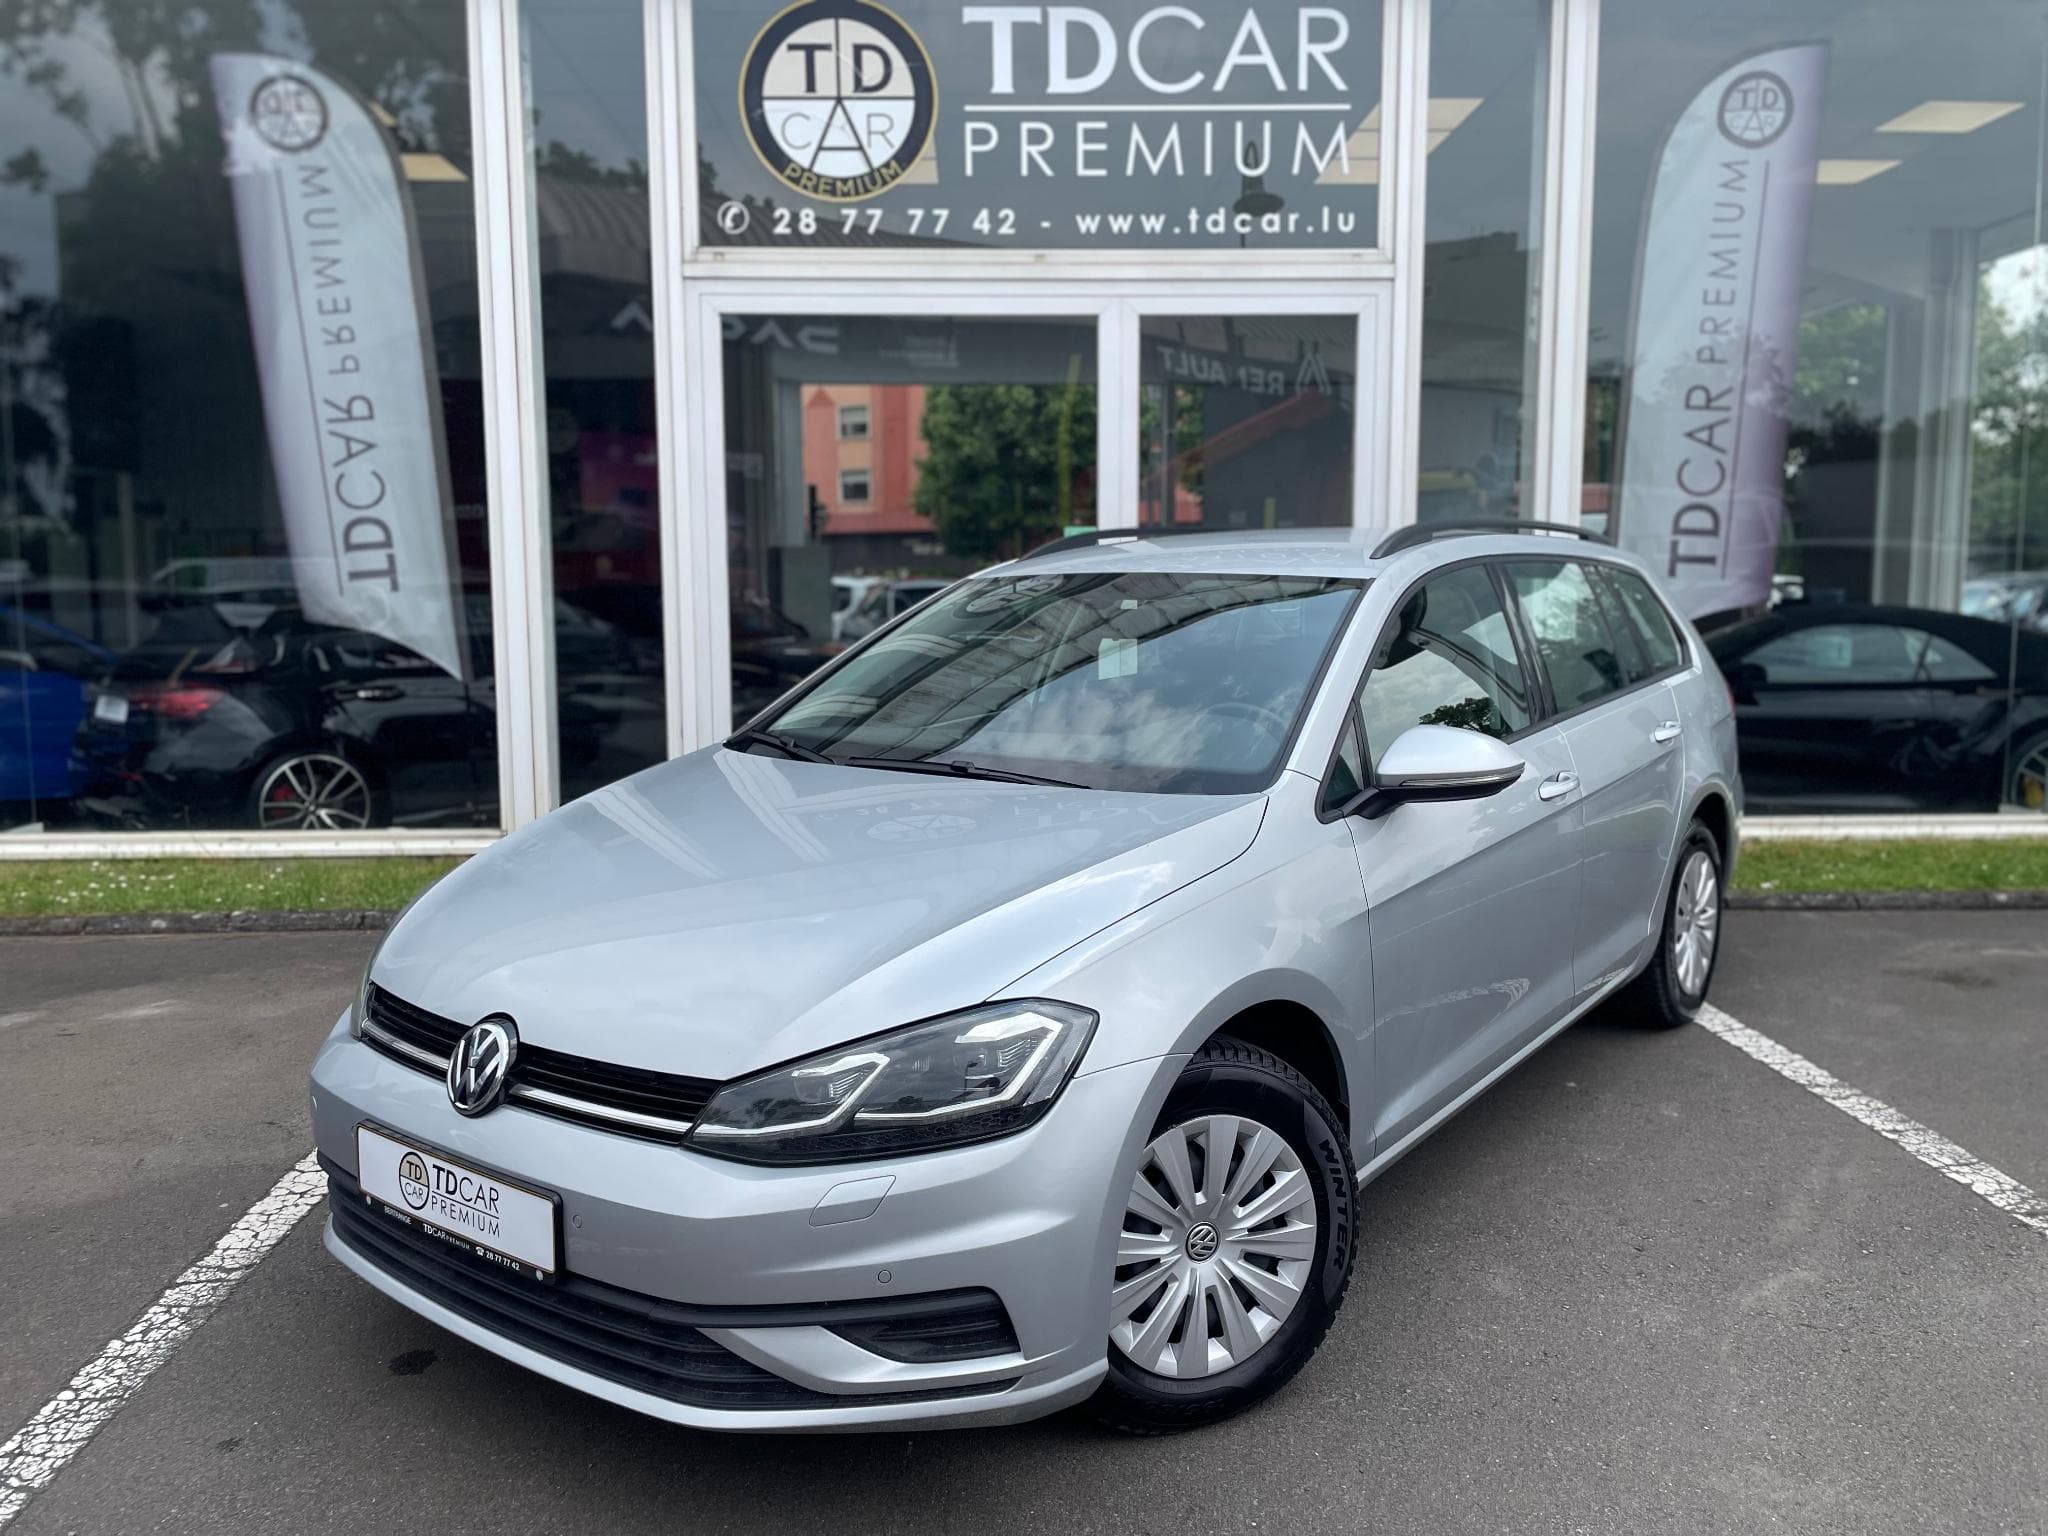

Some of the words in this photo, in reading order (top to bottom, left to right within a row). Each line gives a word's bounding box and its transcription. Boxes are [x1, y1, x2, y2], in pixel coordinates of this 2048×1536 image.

[786, 43, 893, 94] TD
[962, 6, 1350, 94] TDCAR
[1736, 86, 1779, 111] TD
[781, 99, 895, 172] CAR
[963, 120, 1351, 177] PREMIUM
[783, 159, 904, 198] PREMIUM
[773, 207, 818, 236] 28
[840, 208, 884, 235] 77
[907, 208, 950, 235] 77
[972, 208, 1017, 235] 42
[1074, 206, 1356, 234] www.tdcar.lu
[1695, 158, 1751, 366] PREMIUM
[1667, 383, 1734, 579] TDCAR
[404, 1182, 424, 1202] CAR
[406, 1160, 423, 1181] TD
[432, 1163, 500, 1214] TDCAR
[431, 1194, 500, 1239] PREMIUM
[1318, 1138, 1349, 1271] WINTER
